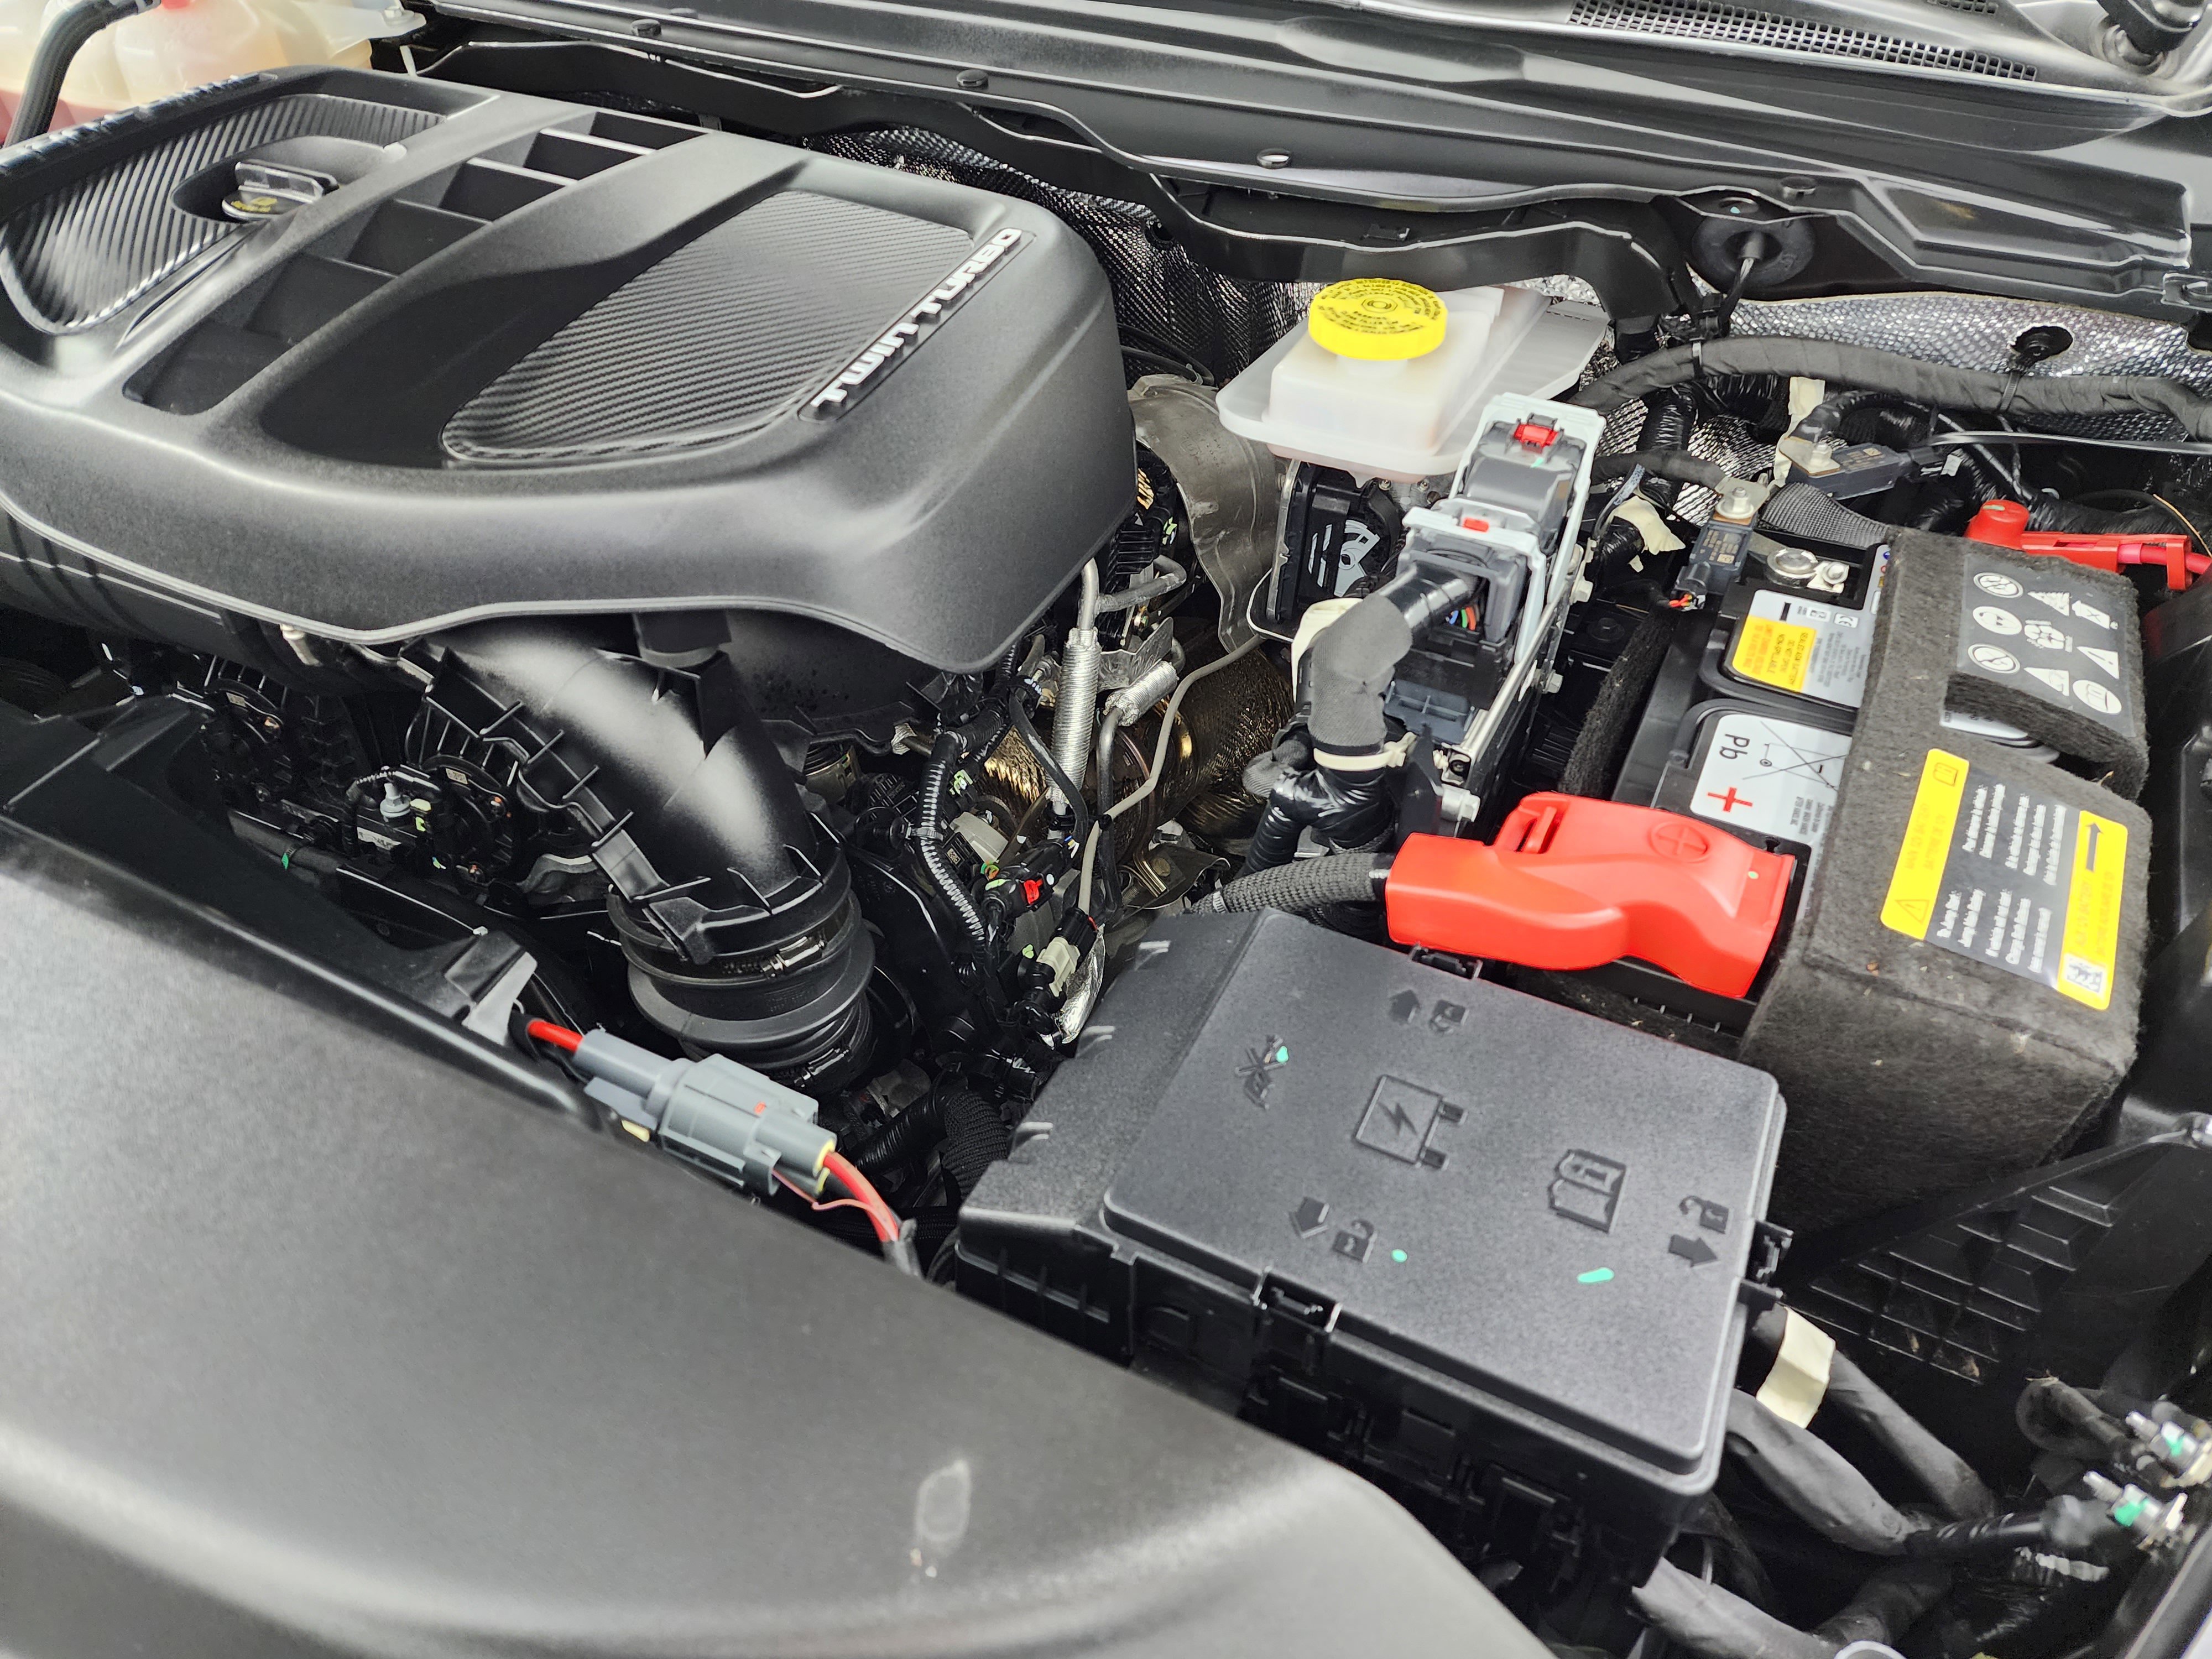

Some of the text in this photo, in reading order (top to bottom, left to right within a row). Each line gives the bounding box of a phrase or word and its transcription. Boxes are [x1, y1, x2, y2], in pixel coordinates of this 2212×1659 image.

[810, 227, 1022, 408] TWIN TURBO
[1719, 734, 1750, 760] Pb
